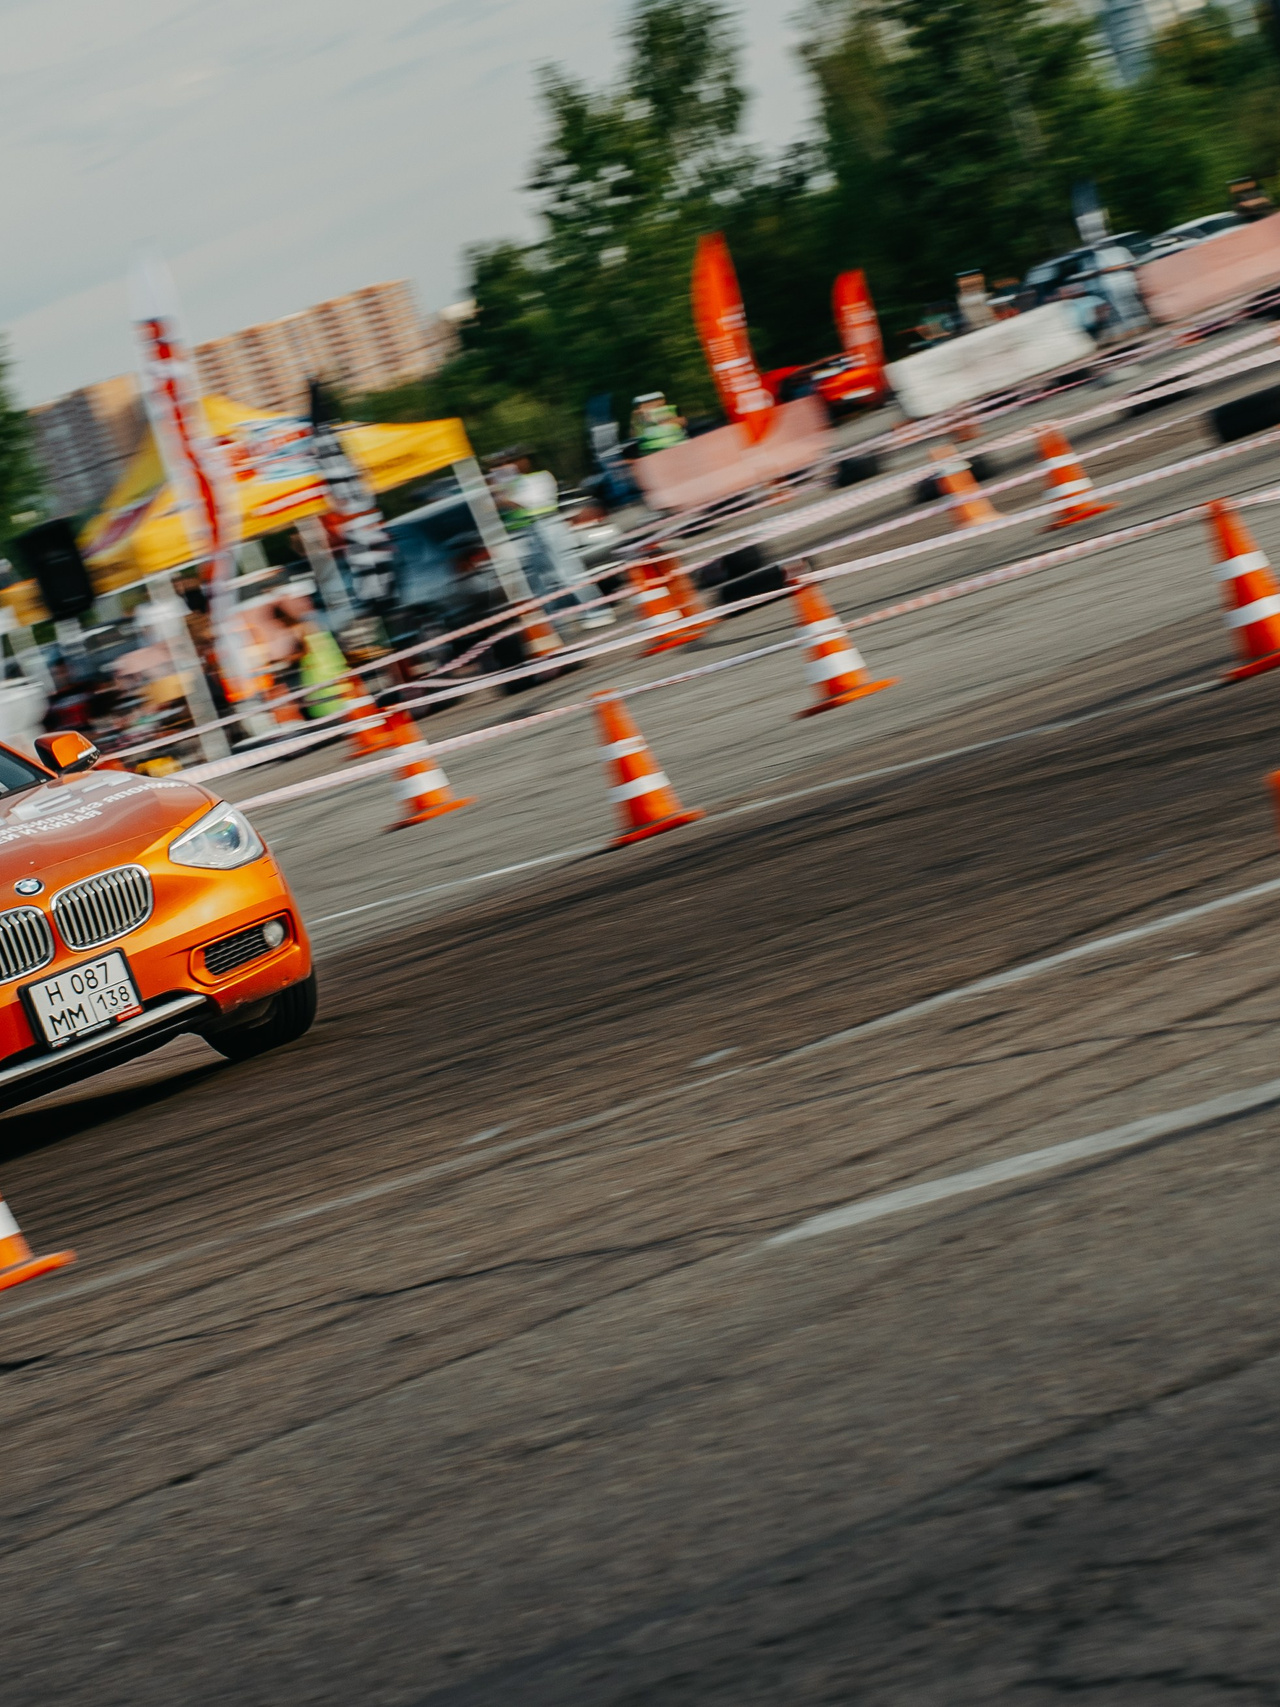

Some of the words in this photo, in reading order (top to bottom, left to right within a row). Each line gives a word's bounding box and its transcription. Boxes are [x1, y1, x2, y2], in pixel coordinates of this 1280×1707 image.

[74, 800, 103, 817] ИЗ
[20, 825, 37, 837] И
[37, 809, 103, 832] КИТАЯ
[70, 962, 109, 994] 087
[96, 986, 130, 1010] 138
